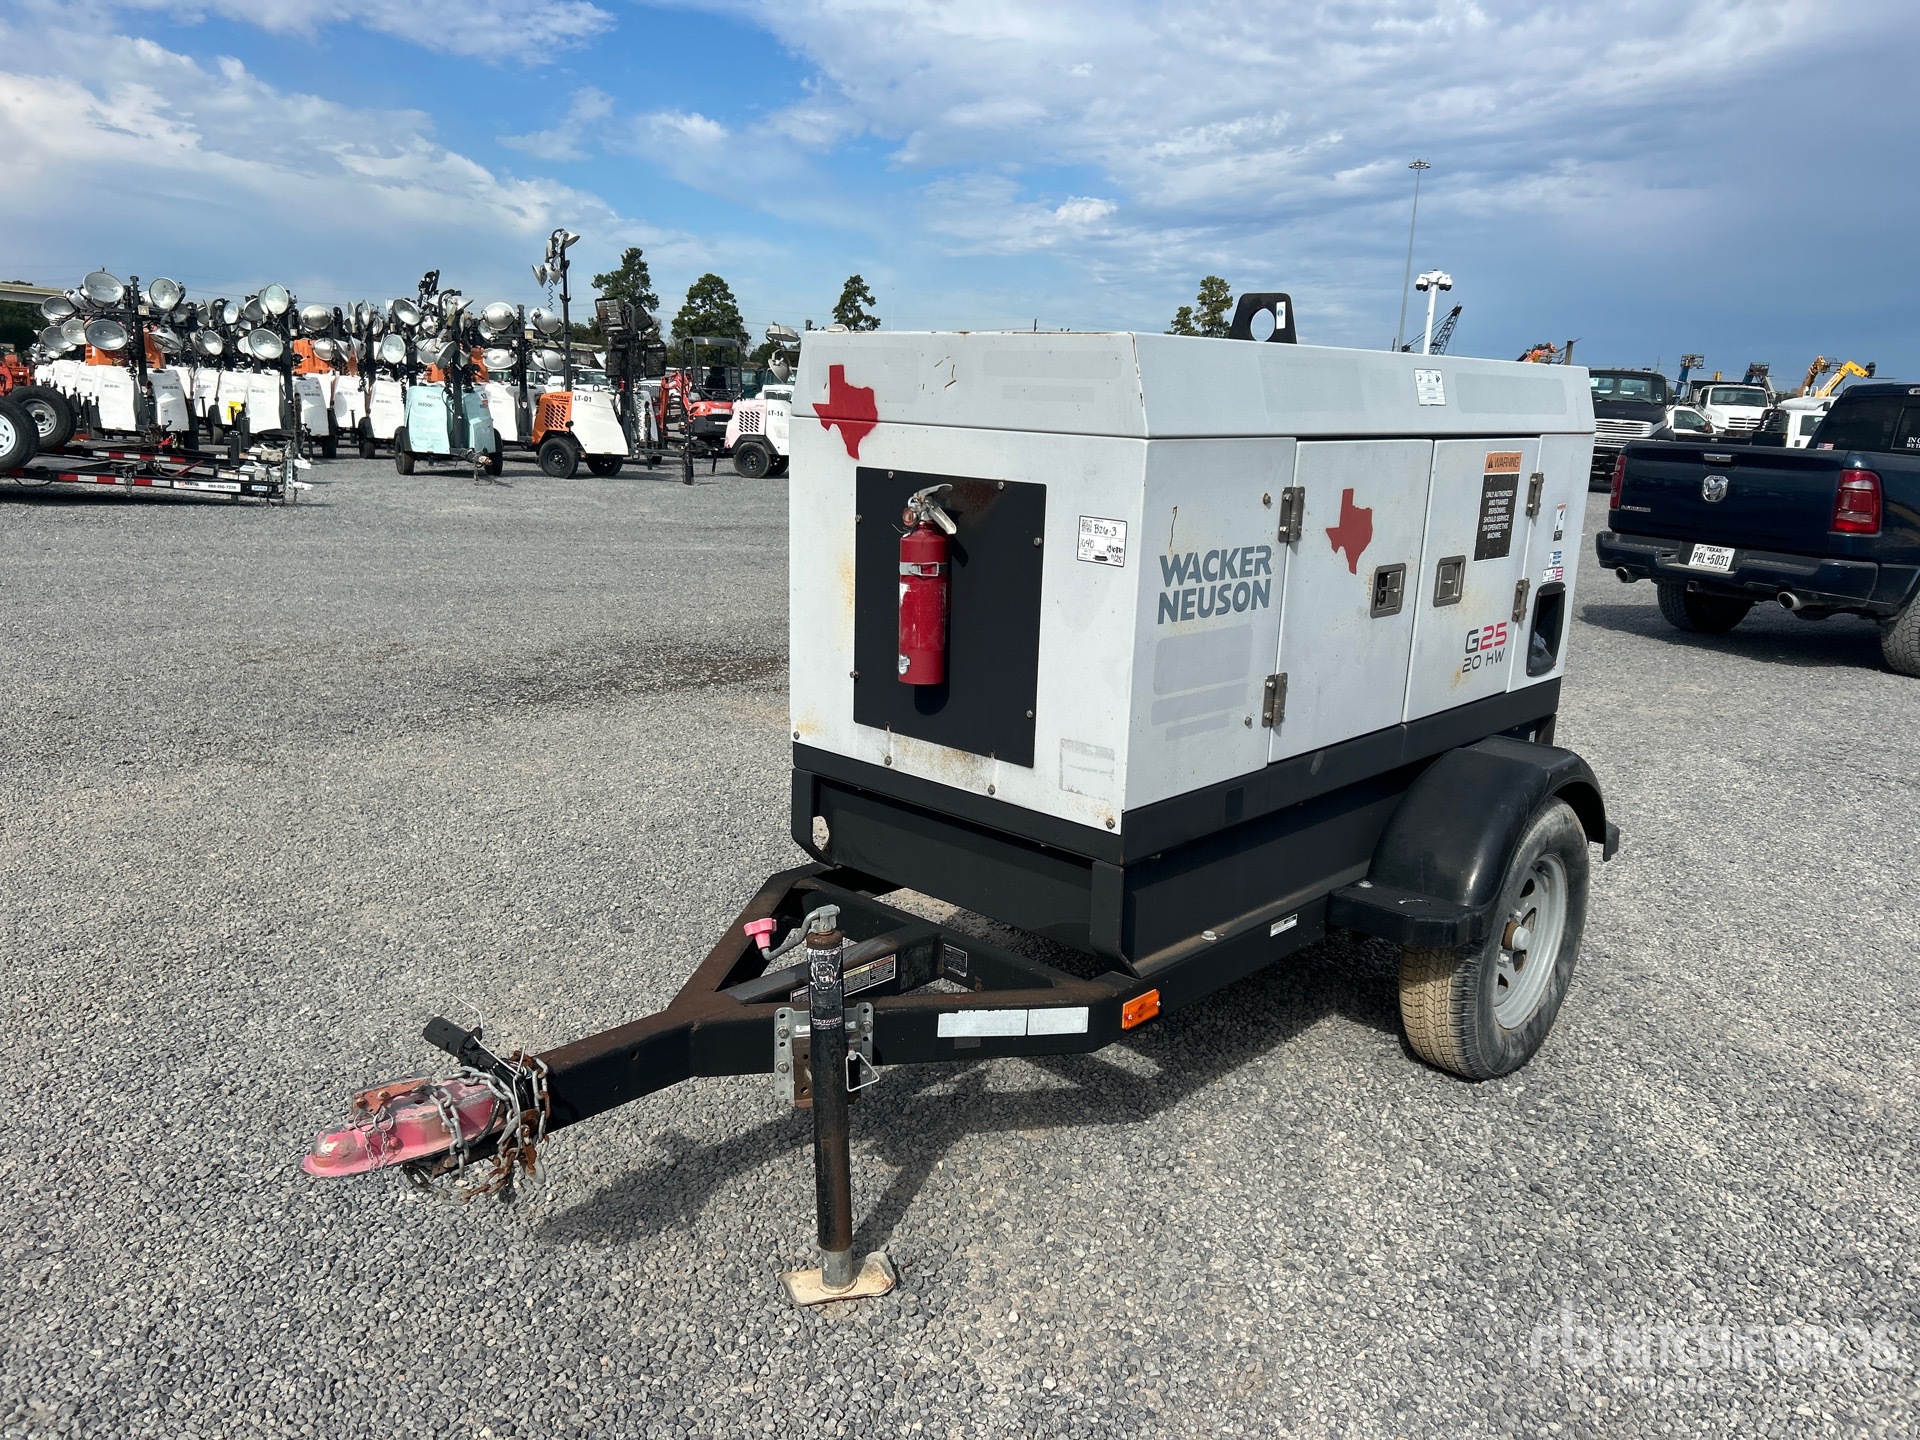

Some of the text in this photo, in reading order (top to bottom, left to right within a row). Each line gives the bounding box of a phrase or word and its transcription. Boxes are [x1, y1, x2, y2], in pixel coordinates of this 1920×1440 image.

[574, 394, 592, 403] LT-01
[1494, 456, 1520, 468] WARNING
[1159, 545, 1272, 588] WACKER
[1157, 578, 1272, 625] NEUSON
[1465, 622, 1507, 654] G25
[1461, 654, 1482, 674] 20
